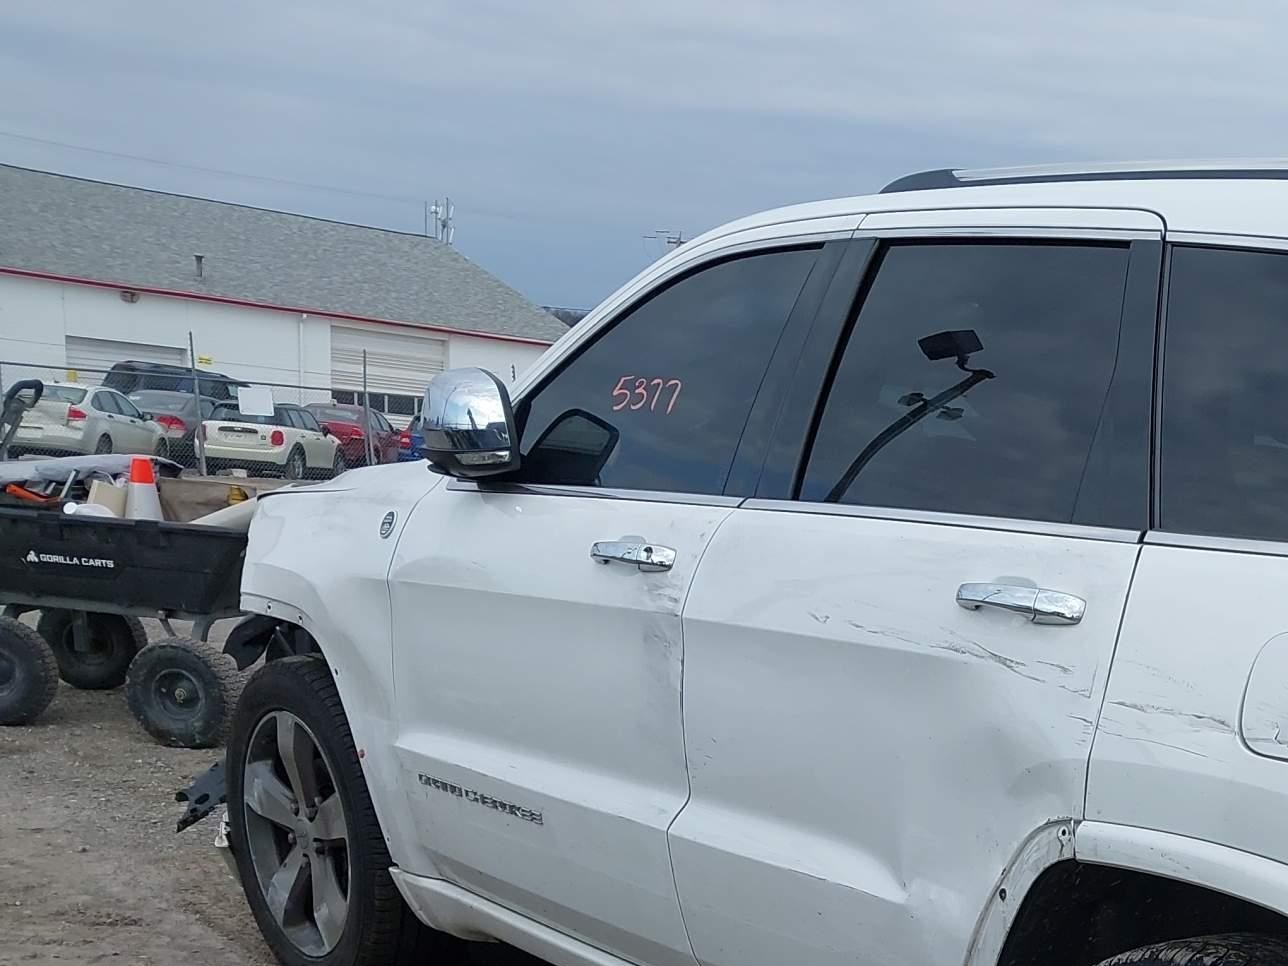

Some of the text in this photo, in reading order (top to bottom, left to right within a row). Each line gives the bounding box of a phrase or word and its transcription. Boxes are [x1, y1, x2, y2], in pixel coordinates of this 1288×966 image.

[612, 375, 682, 415] 5377
[39, 553, 115, 569] GORILLA CARTS
